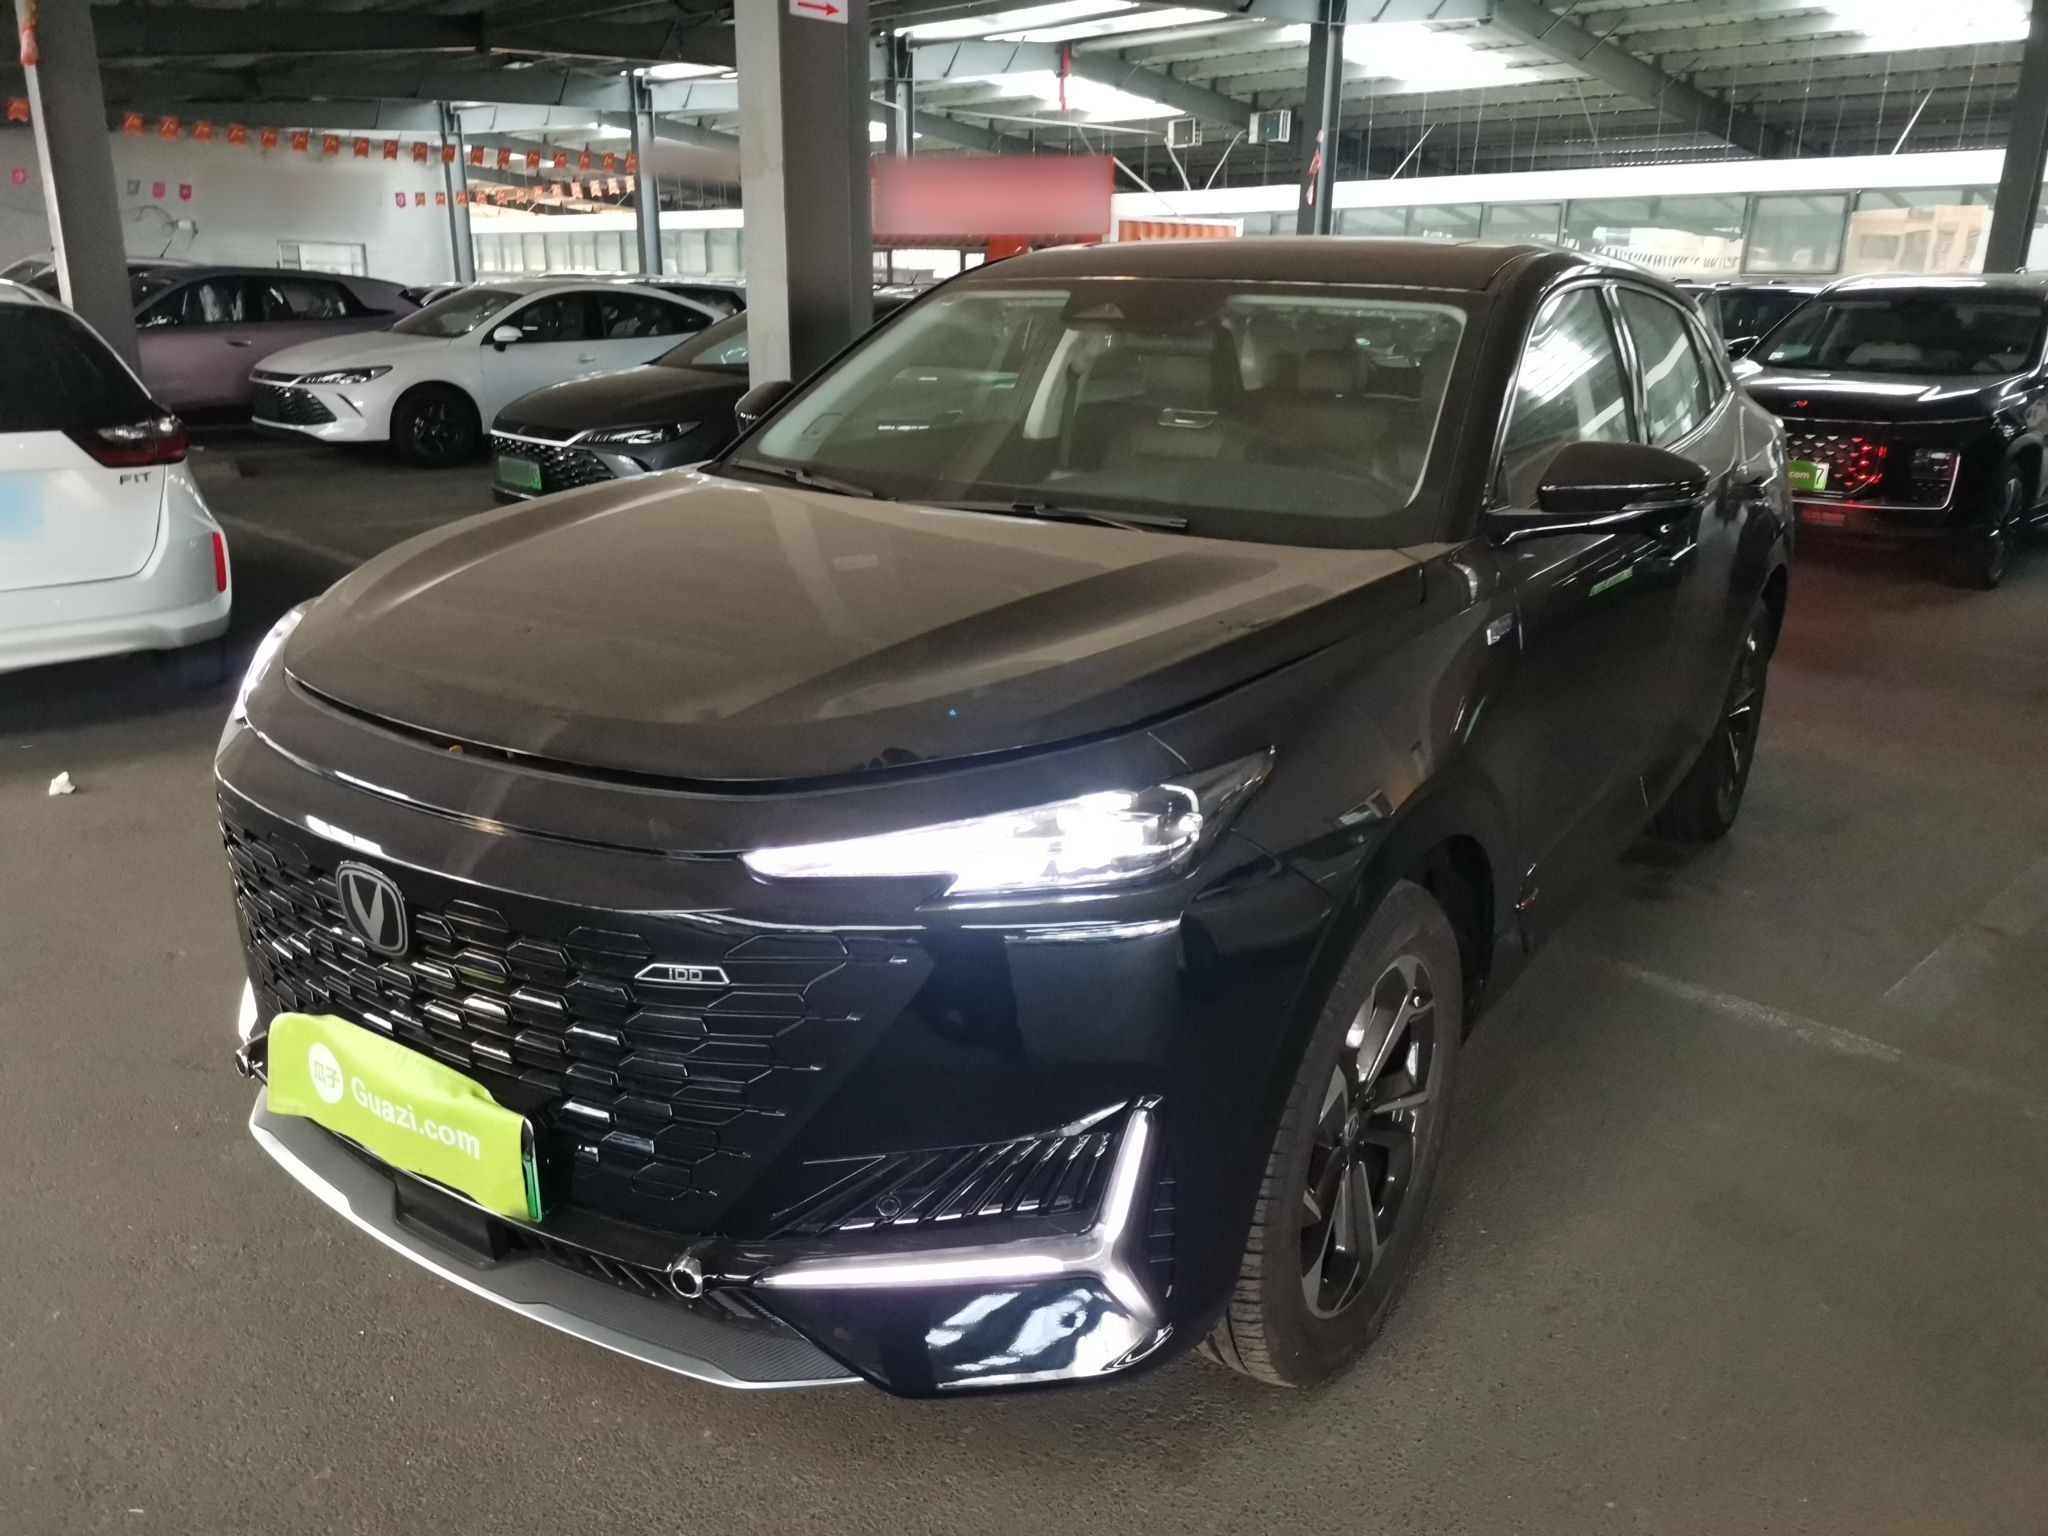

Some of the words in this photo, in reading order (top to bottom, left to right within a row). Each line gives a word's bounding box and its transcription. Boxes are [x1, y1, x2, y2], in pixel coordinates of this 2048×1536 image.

[120, 471, 152, 485] FIT
[313, 1060, 340, 1089] 瓜子
[351, 1076, 481, 1161] Guazi.com
